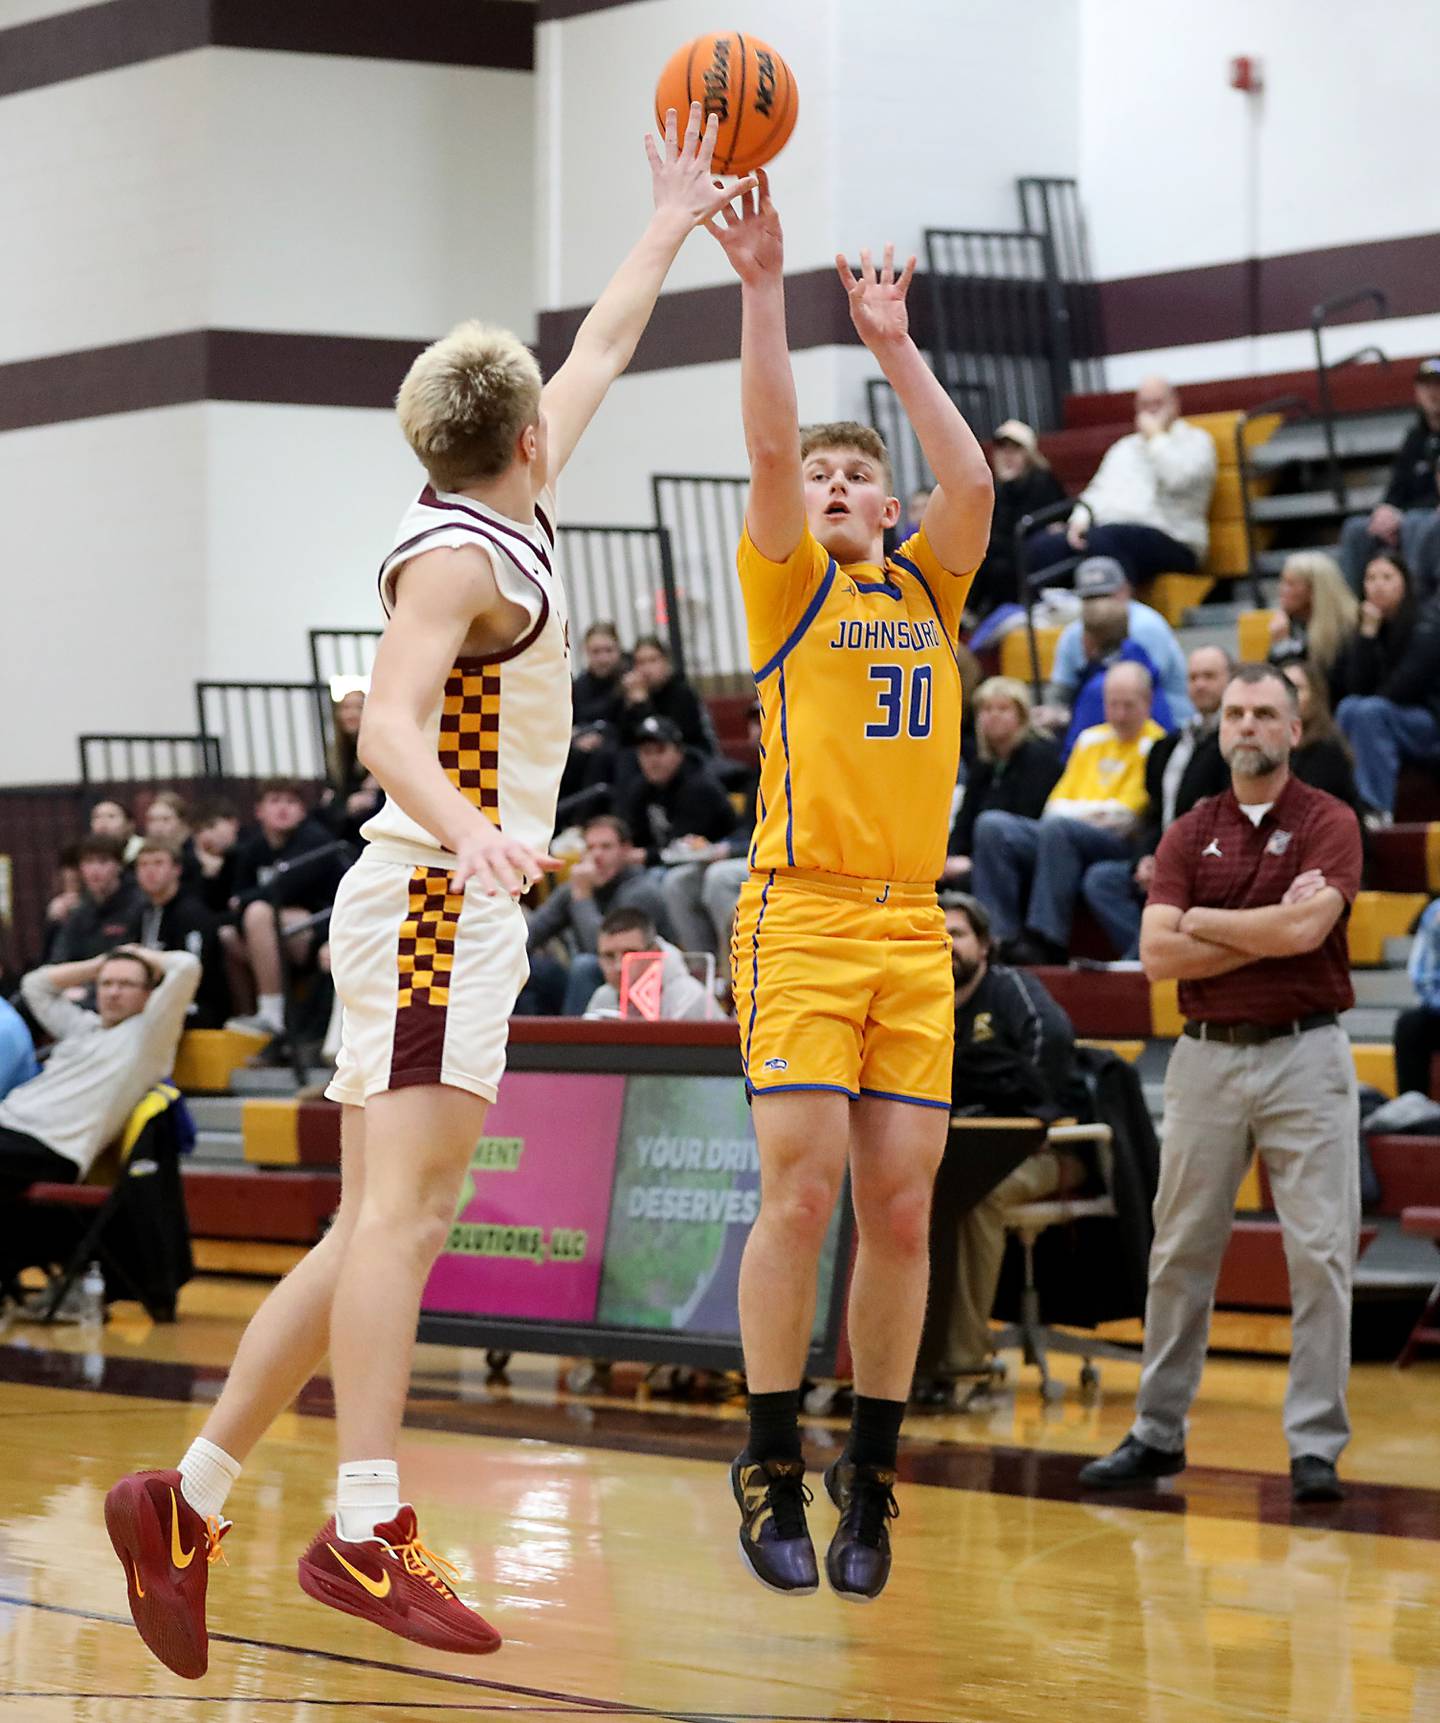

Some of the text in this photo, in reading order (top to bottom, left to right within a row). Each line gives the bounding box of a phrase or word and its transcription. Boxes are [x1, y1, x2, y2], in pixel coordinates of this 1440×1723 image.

[864, 663, 933, 739] 30
[636, 1135, 703, 1170] YOUR
[628, 1186, 760, 1223] DESERVES
[552, 1232, 584, 1257] LLC
